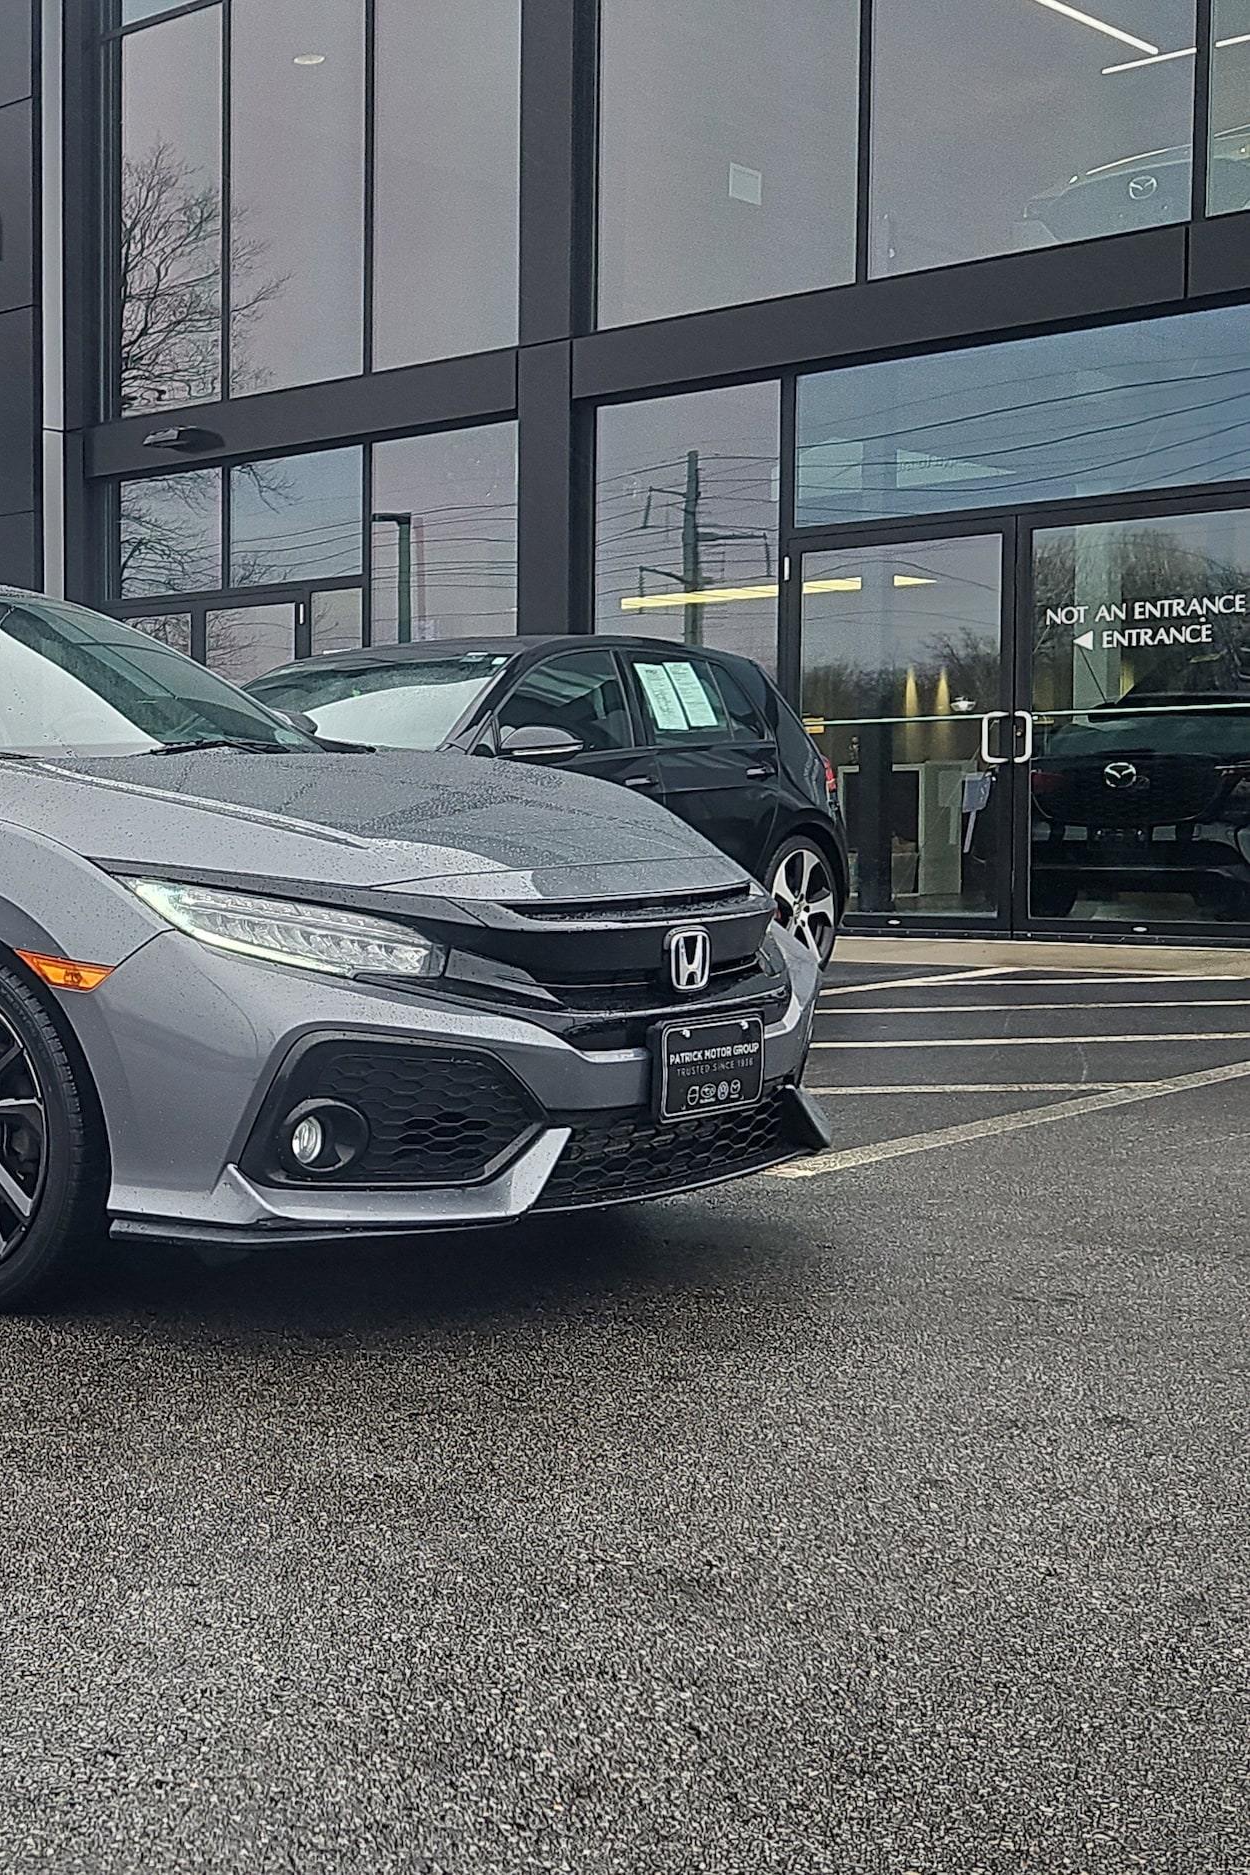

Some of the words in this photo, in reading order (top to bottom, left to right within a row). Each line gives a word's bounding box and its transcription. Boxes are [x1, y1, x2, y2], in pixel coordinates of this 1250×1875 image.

[1046, 606, 1088, 625] NOT
[1095, 603, 1127, 622] AN
[1133, 594, 1246, 620] ENTRANCE
[1102, 624, 1213, 648] ENTRANCE
[670, 1050, 703, 1065] PATRICK
[704, 1046, 732, 1060] MOTOR
[733, 1042, 760, 1056] GROUP
[676, 1065, 710, 1077] TRUSTED
[712, 1060, 735, 1072] SINCE
